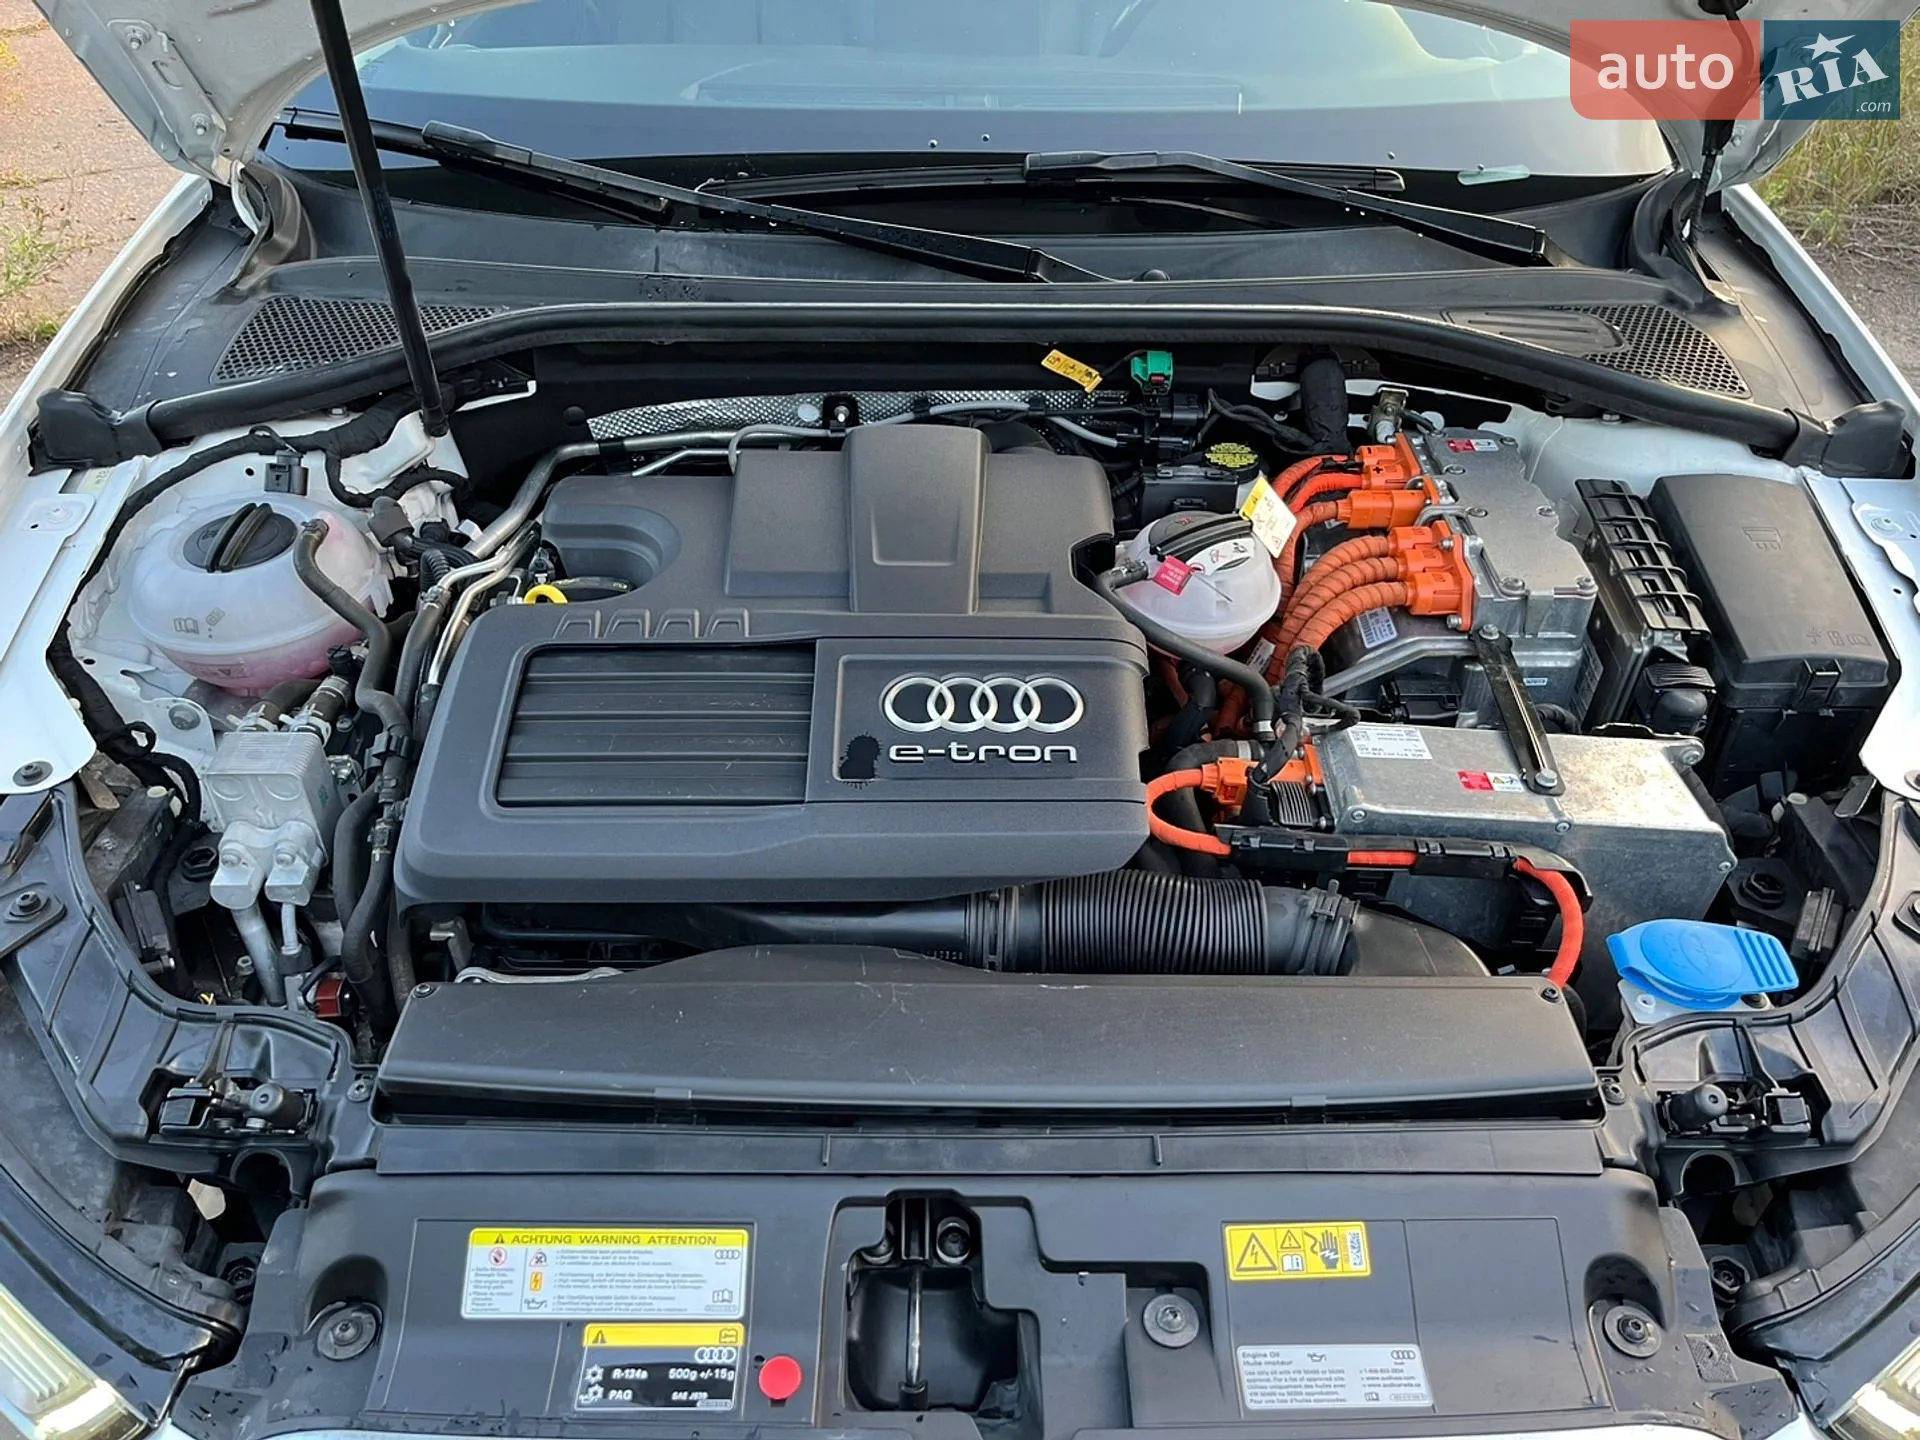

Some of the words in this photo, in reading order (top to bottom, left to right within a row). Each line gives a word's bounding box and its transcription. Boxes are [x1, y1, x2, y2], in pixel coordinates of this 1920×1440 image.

[888, 741, 1079, 763] e-tron
[511, 1234, 572, 1244] ACHTUNG
[579, 1234, 641, 1245] WARNING
[647, 1235, 718, 1245] ATTENTION
[1242, 1351, 1267, 1360] Engine
[608, 1389, 633, 1401] PAG
